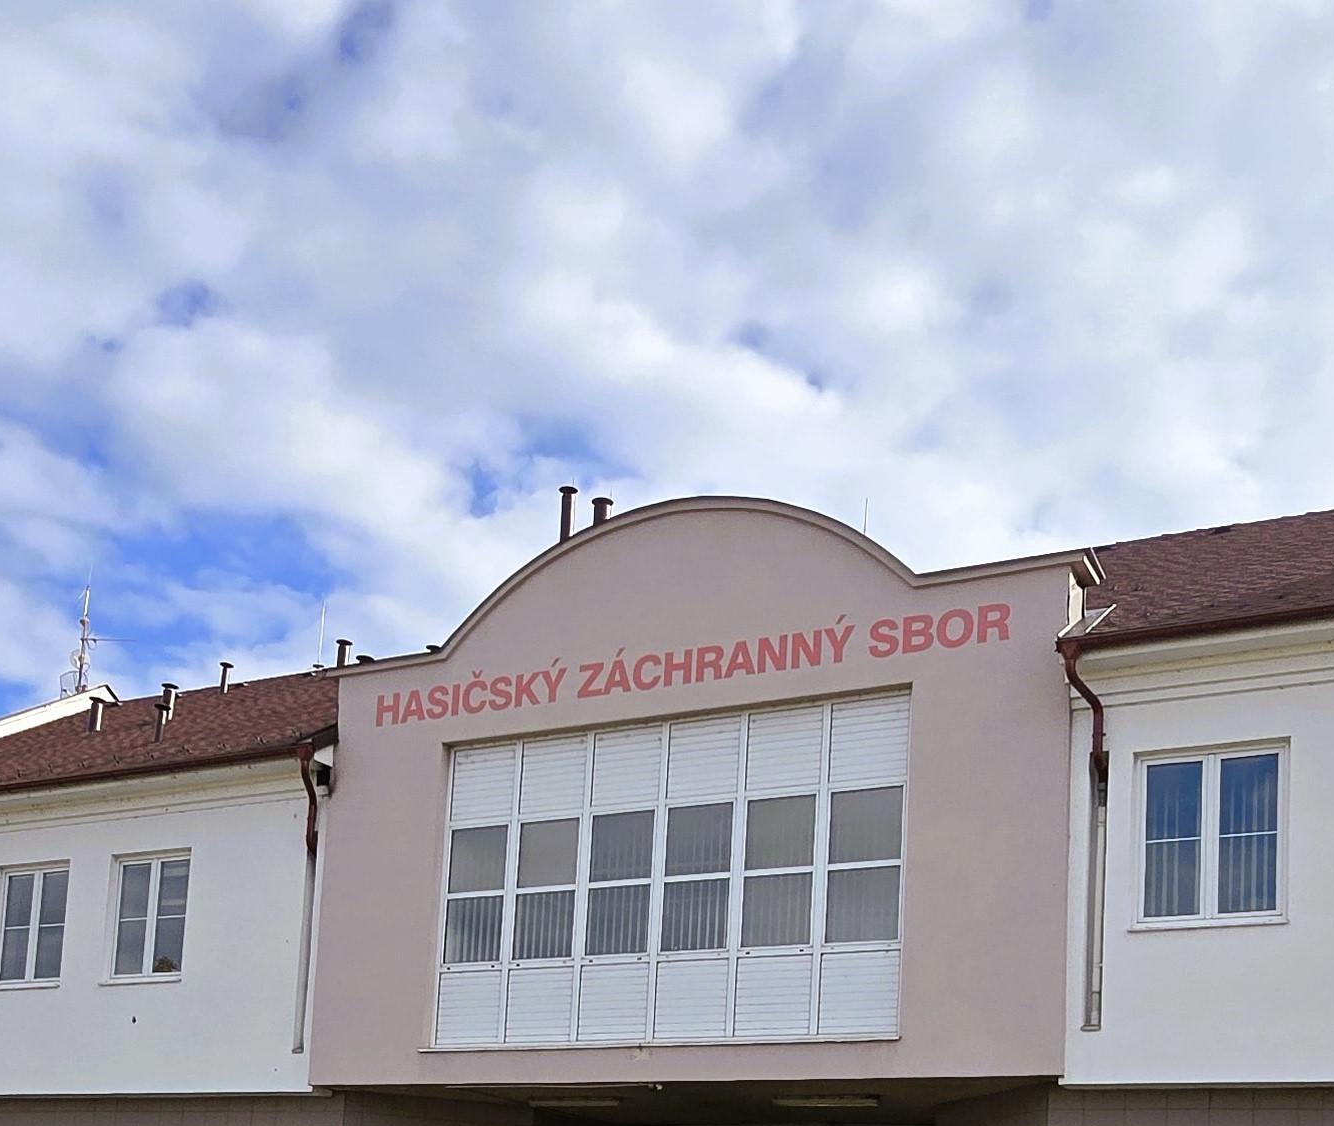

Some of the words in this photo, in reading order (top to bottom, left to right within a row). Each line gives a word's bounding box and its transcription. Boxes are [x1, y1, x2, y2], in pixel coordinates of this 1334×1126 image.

[375, 658, 568, 726] HASIČSKÝ
[576, 614, 855, 698] ZÁCHRANNÝ
[867, 603, 1012, 659] SBOR
